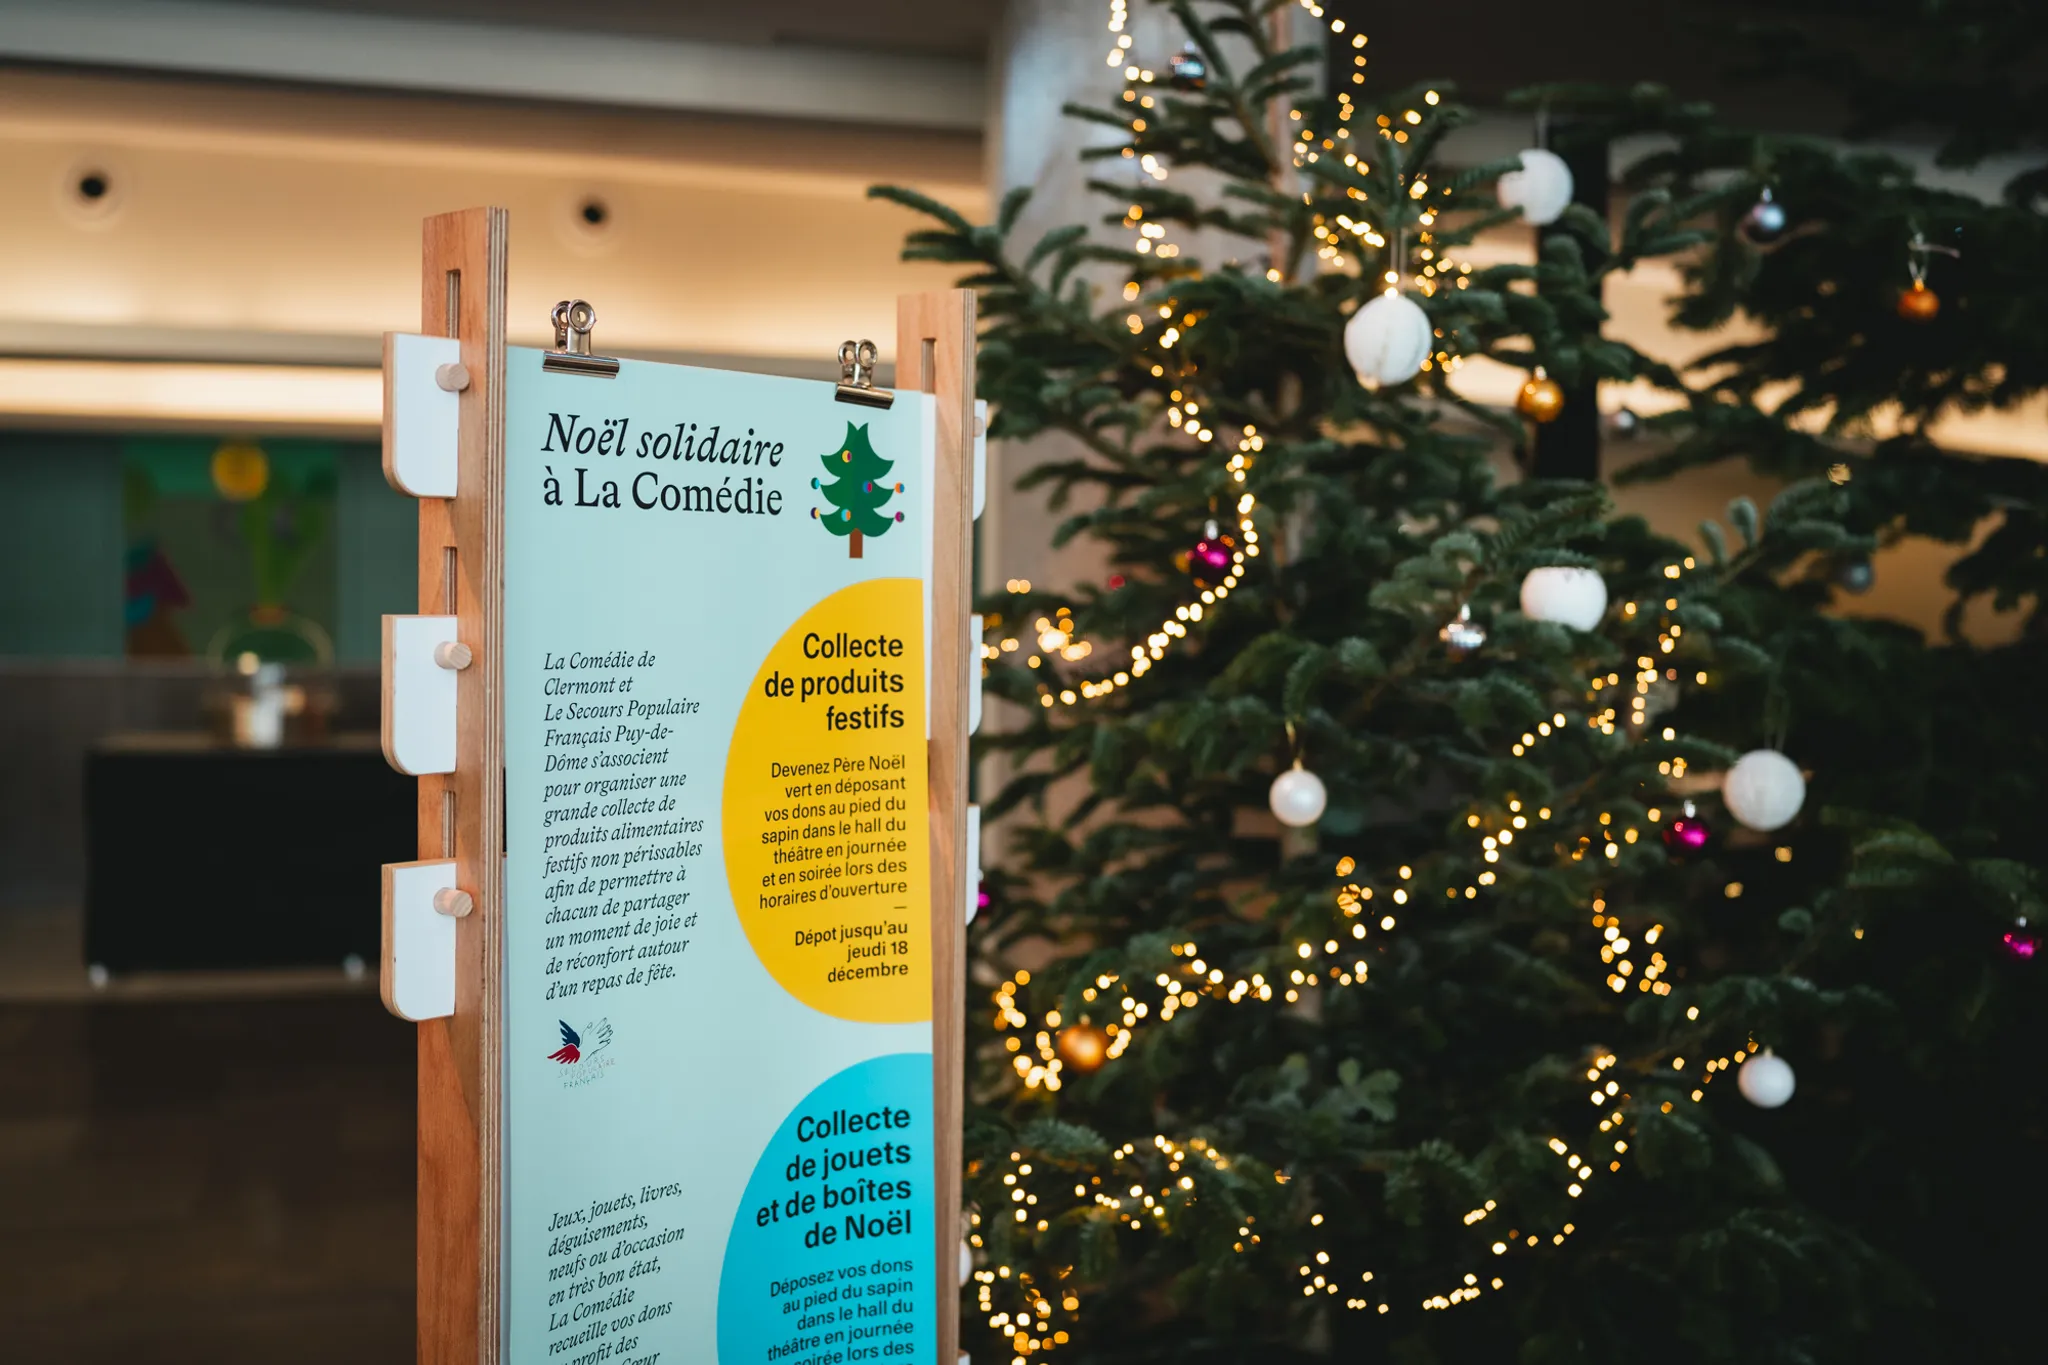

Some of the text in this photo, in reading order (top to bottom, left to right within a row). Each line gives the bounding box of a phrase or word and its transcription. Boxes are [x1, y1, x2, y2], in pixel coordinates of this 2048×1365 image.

[541, 413, 784, 467] Noël solidaire
[543, 466, 783, 515] à La Comédie
[544, 651, 656, 670] La Comédie de
[803, 632, 904, 659] Collecte
[544, 676, 633, 696] Clermont et
[765, 668, 904, 702] de produits
[544, 698, 700, 721] Le Secours Populaire
[827, 703, 904, 731] festifs
[544, 723, 673, 748] Français Puy-de-
[544, 753, 588, 772] Dôme
[772, 754, 905, 778] Devenez Père Noël
[543, 773, 687, 802] pour organiser une
[785, 777, 906, 798] vert en déposant
[543, 795, 676, 827] grande collecte de
[765, 796, 906, 822] vos dons au pied du
[544, 818, 704, 851] produits alimentaires
[762, 817, 906, 845] sapin dans le hall du
[542, 841, 702, 879] festifs non périssables
[774, 838, 906, 864] théâtre en journée
[545, 865, 687, 903] afin de permettre à
[762, 859, 907, 887] et en soirée lors des
[545, 891, 690, 925] chacun de partager
[760, 890, 816, 909] horaires
[545, 912, 698, 950] un moment de joie et
[795, 927, 837, 946] Dépot
[546, 939, 690, 976] de réconfort autour
[847, 941, 908, 962] jeudi 18
[582, 973, 623, 995] repas
[625, 967, 643, 984] de
[645, 963, 676, 986] fête.
[828, 963, 908, 983] décembre
[797, 1106, 911, 1143] Collecte
[786, 1141, 911, 1182] de jouets
[548, 1182, 682, 1232] Jeux, jouets, livres,
[756, 1178, 911, 1227] et de boîtes
[548, 1213, 648, 1257] déguisements,
[805, 1209, 911, 1249] de Noël
[549, 1253, 586, 1282] neufs
[589, 1248, 608, 1267] ou
[549, 1255, 661, 1307] en très bon état,
[770, 1259, 913, 1298] Déposez vos dons
[549, 1287, 635, 1332] La Comédie
[783, 1278, 913, 1315] au pied du sapin
[548, 1302, 672, 1356] recueille vos dons
[797, 1299, 913, 1331] dans le hall du
[615, 1336, 638, 1355] des
[768, 1320, 913, 1361] théâtre en journée
[847, 1347, 879, 1360] lors
[883, 1341, 914, 1357] des
